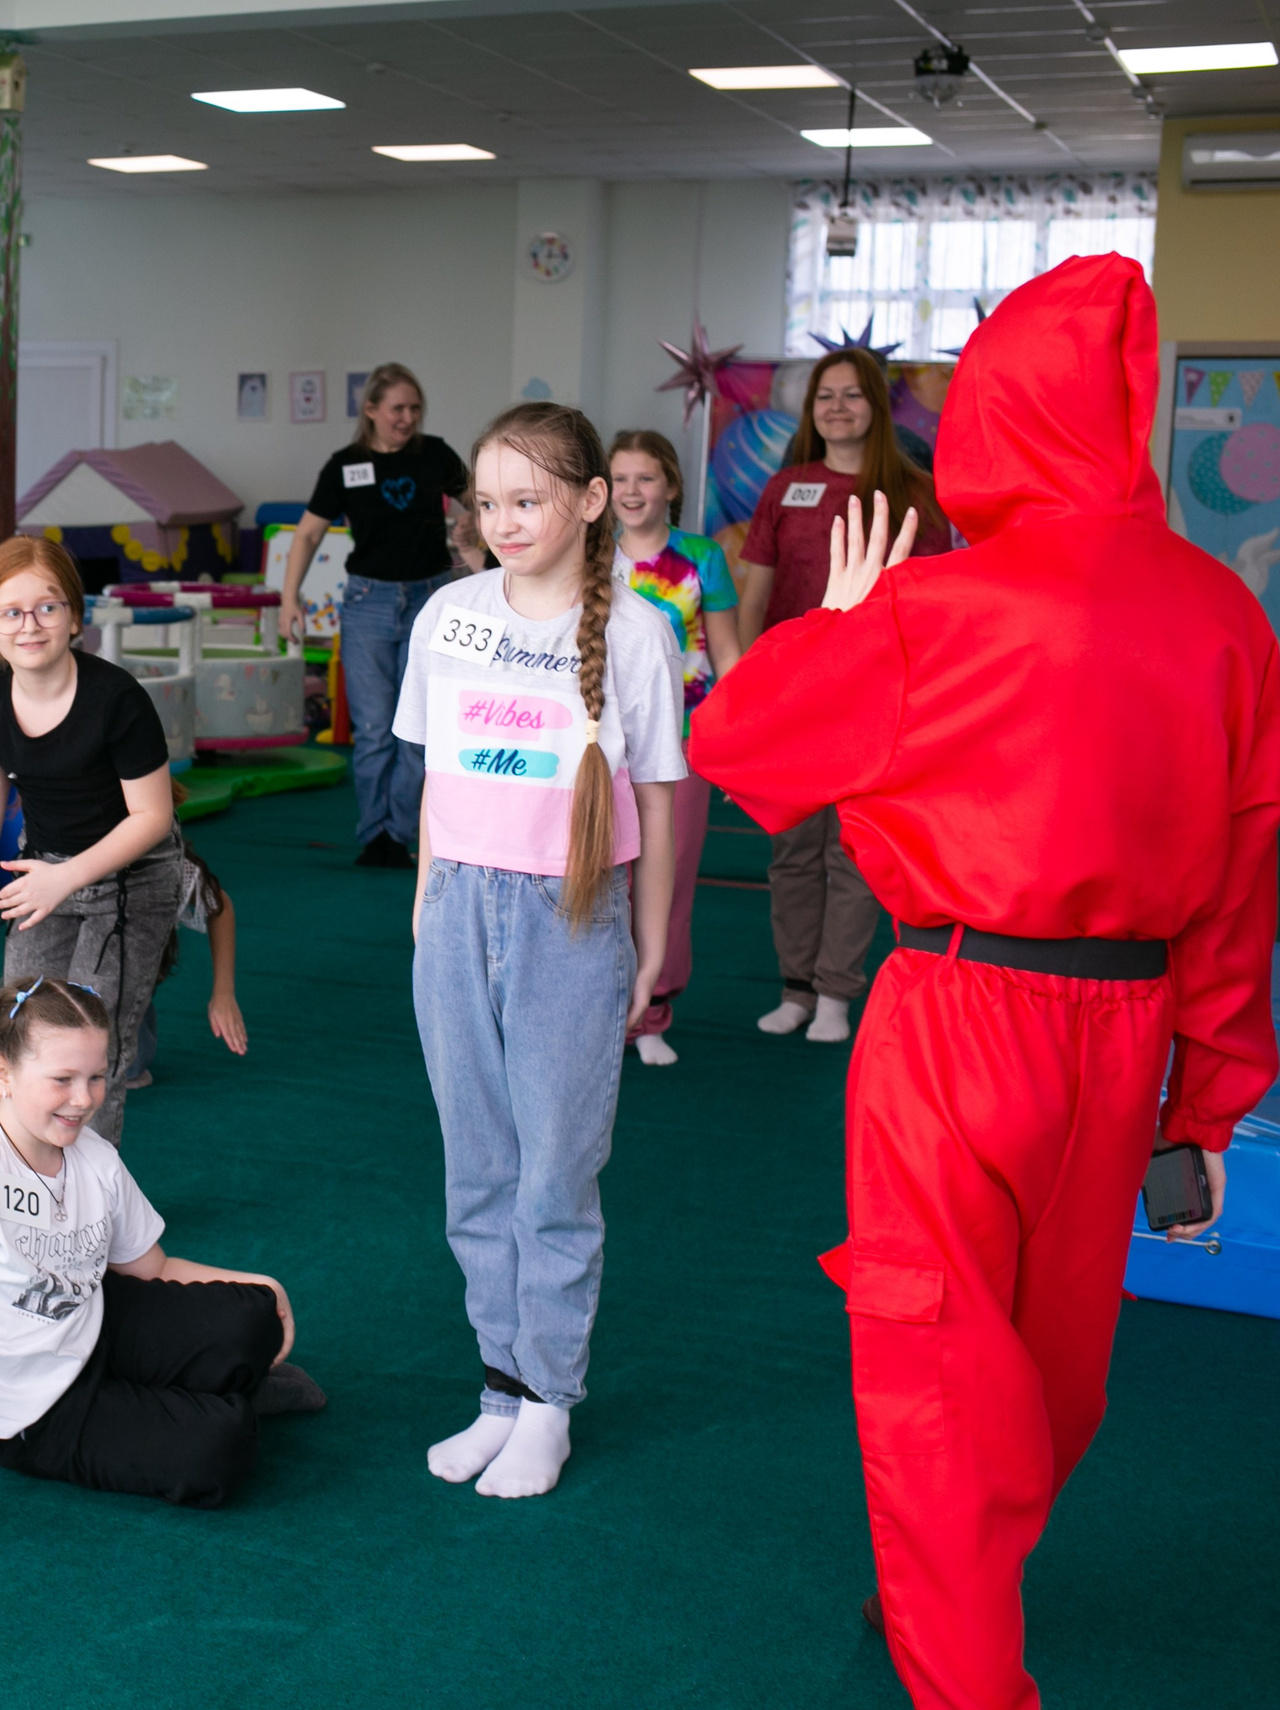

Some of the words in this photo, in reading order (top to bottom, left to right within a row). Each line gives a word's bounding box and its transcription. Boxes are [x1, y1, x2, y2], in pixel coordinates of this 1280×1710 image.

[349, 468, 370, 482] 218
[791, 487, 818, 502] 001
[443, 618, 493, 652] 333
[493, 636, 583, 675] Summer
[463, 699, 546, 730] #Vibes
[471, 748, 528, 776] #Me
[3, 1184, 40, 1217] 120
